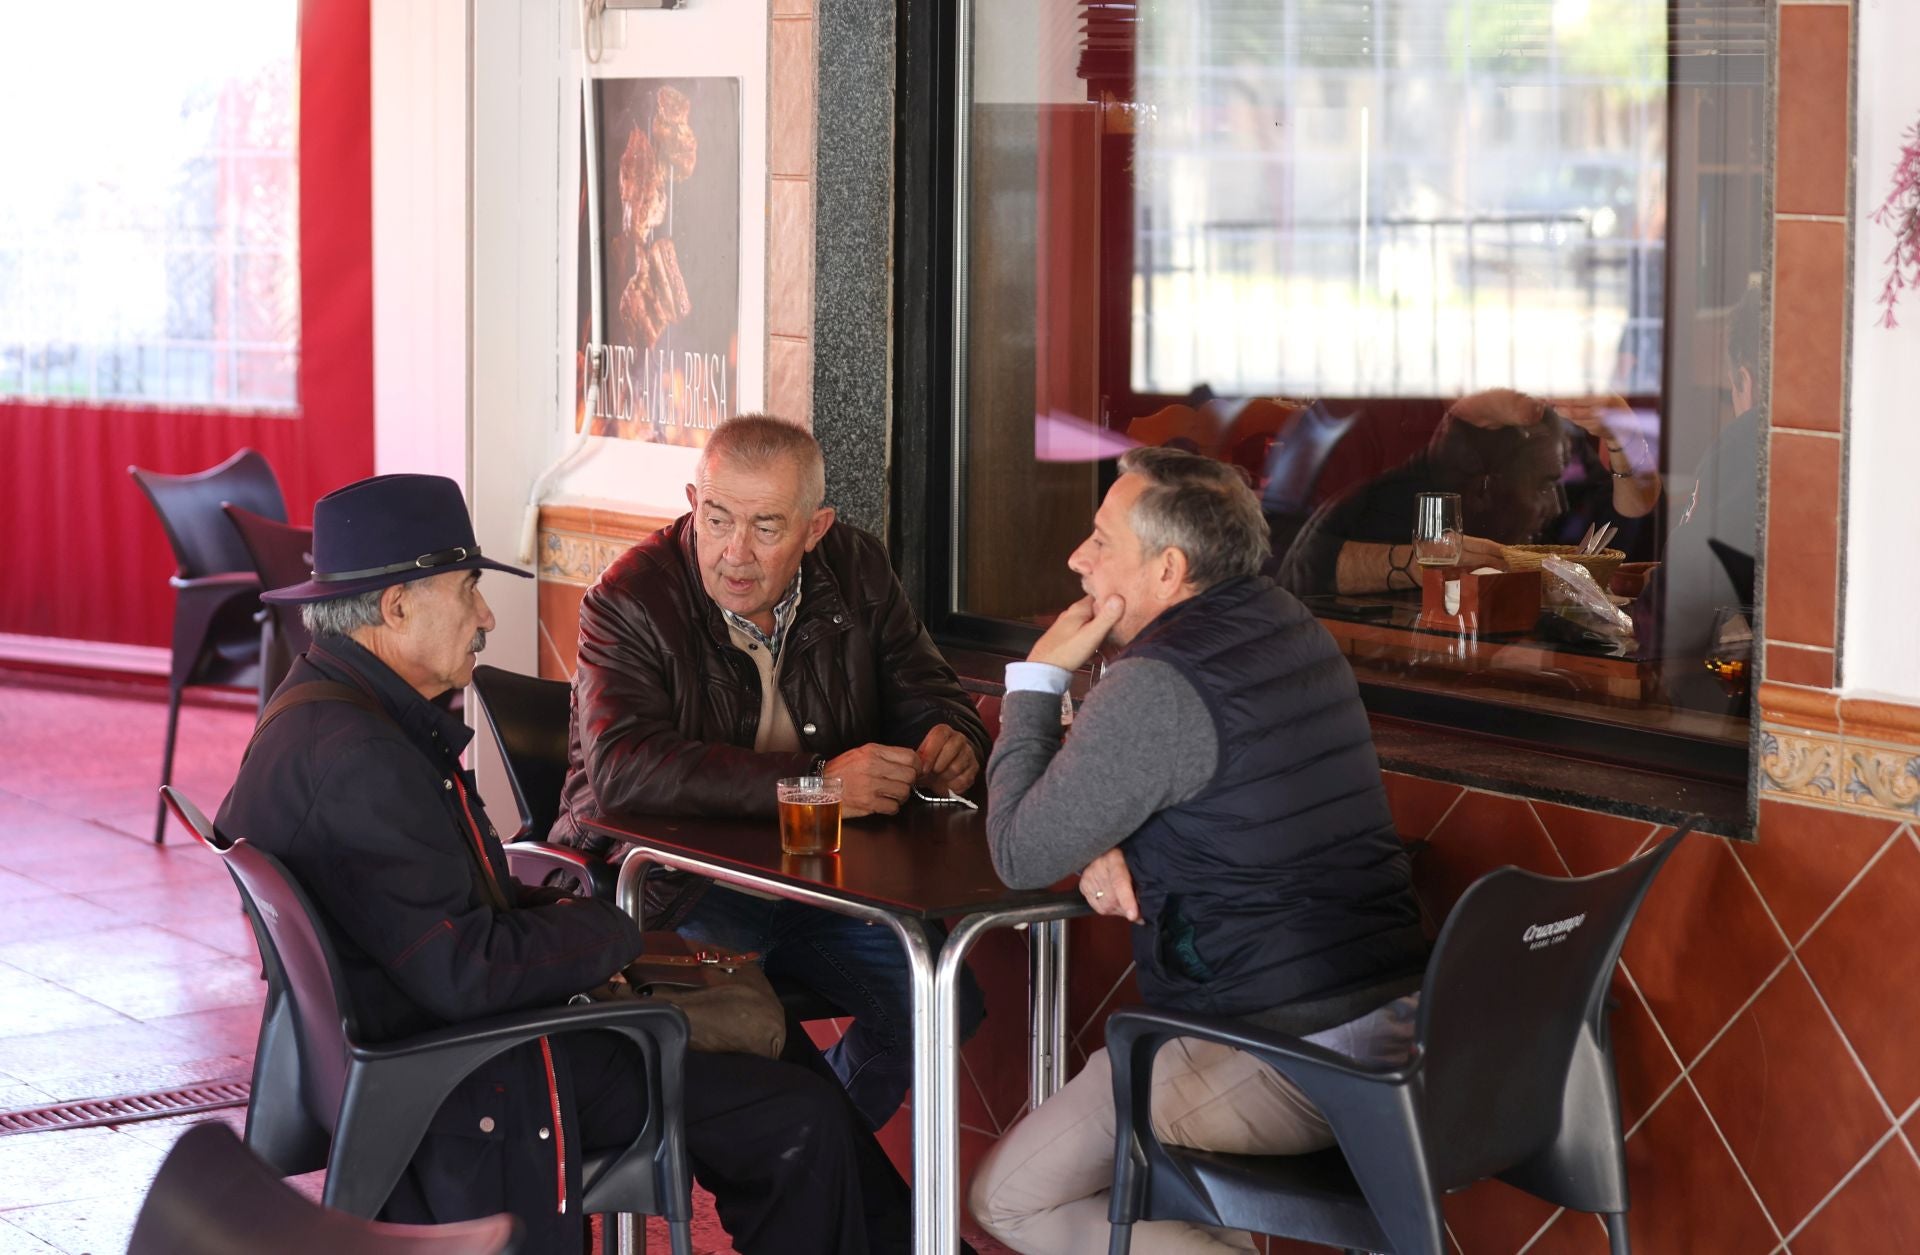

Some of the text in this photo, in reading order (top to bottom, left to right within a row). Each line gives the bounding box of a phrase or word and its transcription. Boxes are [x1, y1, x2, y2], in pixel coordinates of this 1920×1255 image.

[641, 347, 650, 422] A
[659, 349, 676, 425] LA
[684, 351, 727, 430] BRASA
